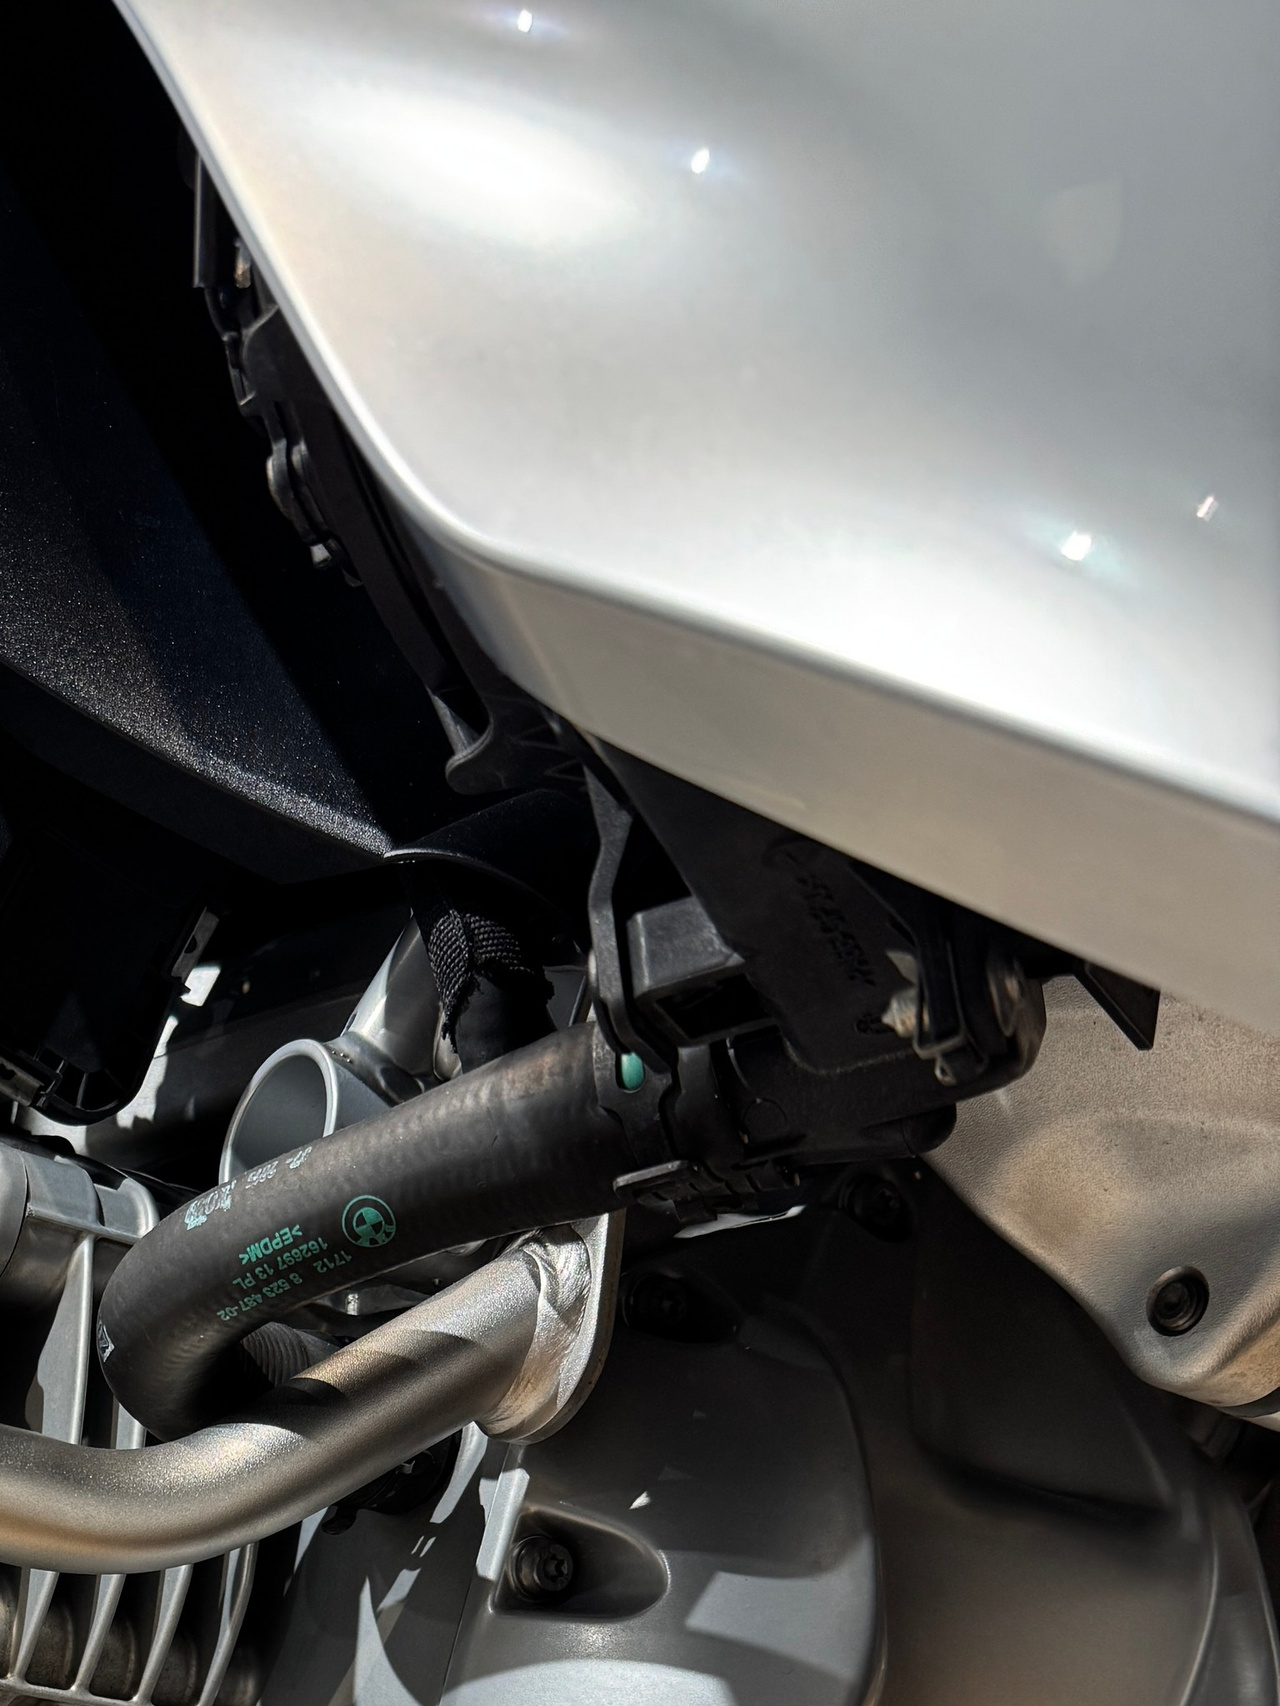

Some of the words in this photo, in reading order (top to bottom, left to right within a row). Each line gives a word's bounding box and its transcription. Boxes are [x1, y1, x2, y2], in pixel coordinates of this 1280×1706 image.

[276, 1237, 328, 1270] 162697
[313, 1251, 352, 1273] 1712
[255, 1263, 274, 1280] 13
[289, 1272, 303, 1285] 8
[232, 1272, 256, 1290] PL
[262, 1279, 291, 1298] 523
